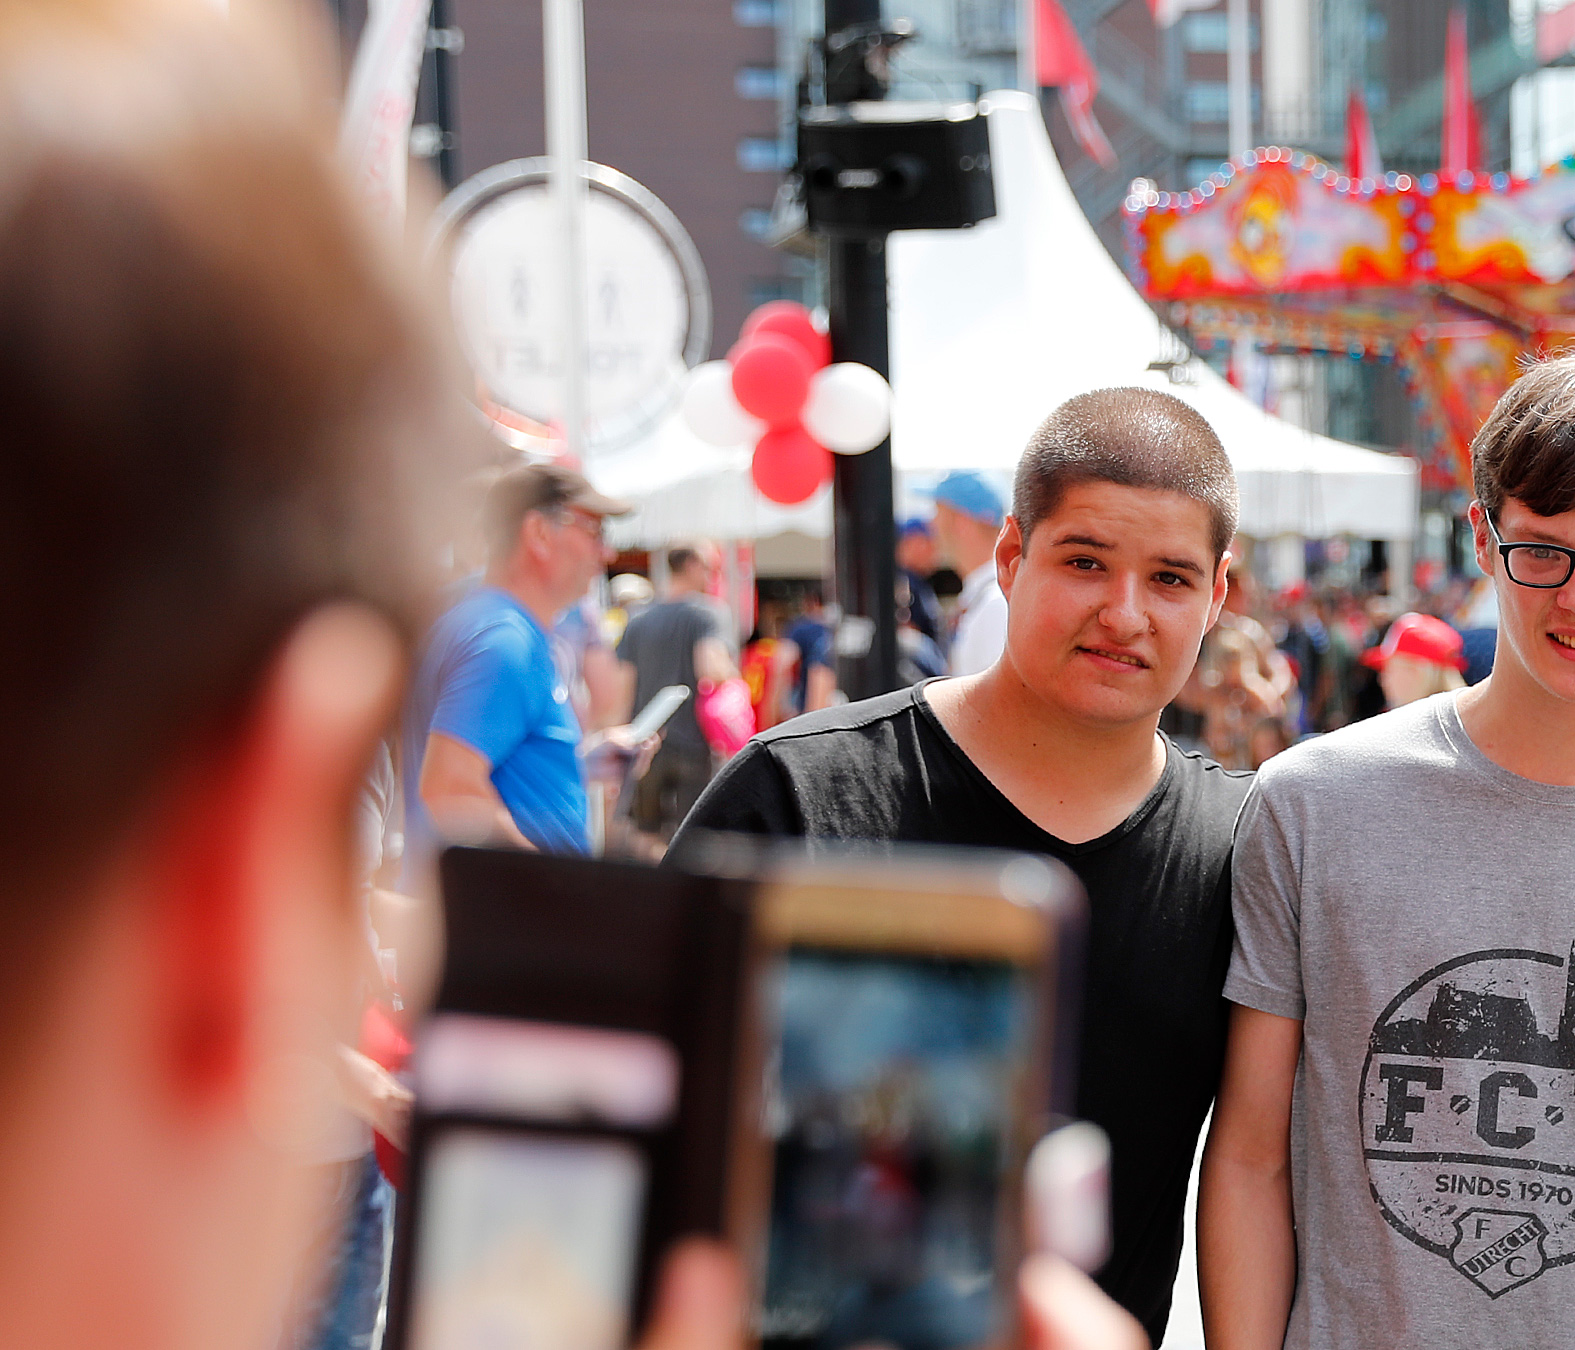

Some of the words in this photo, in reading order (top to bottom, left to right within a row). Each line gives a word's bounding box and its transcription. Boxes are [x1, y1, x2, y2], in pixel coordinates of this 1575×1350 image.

[1435, 1174, 1511, 1198] SINDS
[1519, 1181, 1573, 1206] 1970
[1475, 1218, 1491, 1239] F
[1463, 1221, 1542, 1276] UTRECHT
[1505, 1256, 1527, 1277] C
